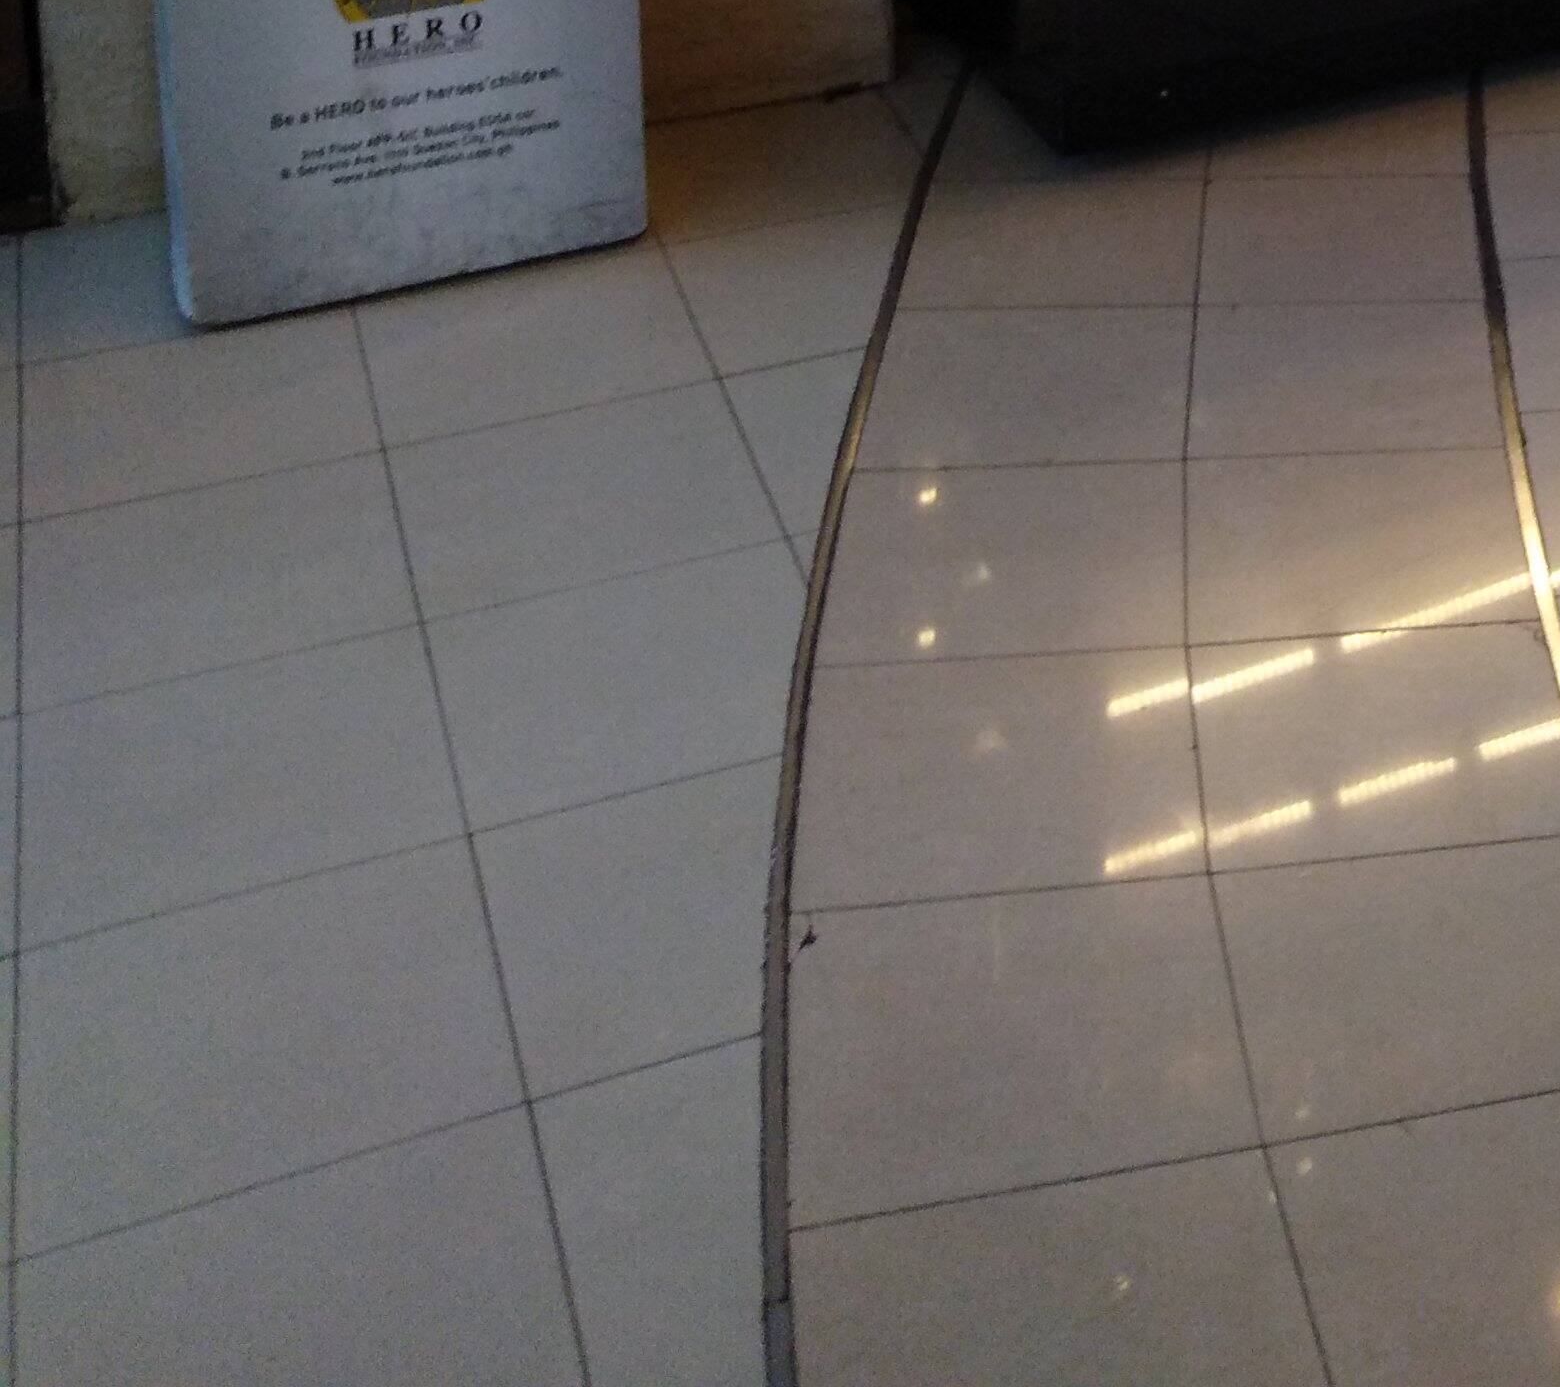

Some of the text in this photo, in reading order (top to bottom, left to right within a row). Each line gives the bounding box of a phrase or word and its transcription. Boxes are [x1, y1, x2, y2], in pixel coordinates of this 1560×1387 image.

[353, 10, 483, 51] HERO
[313, 97, 367, 122] HERO
[390, 91, 421, 108] our
